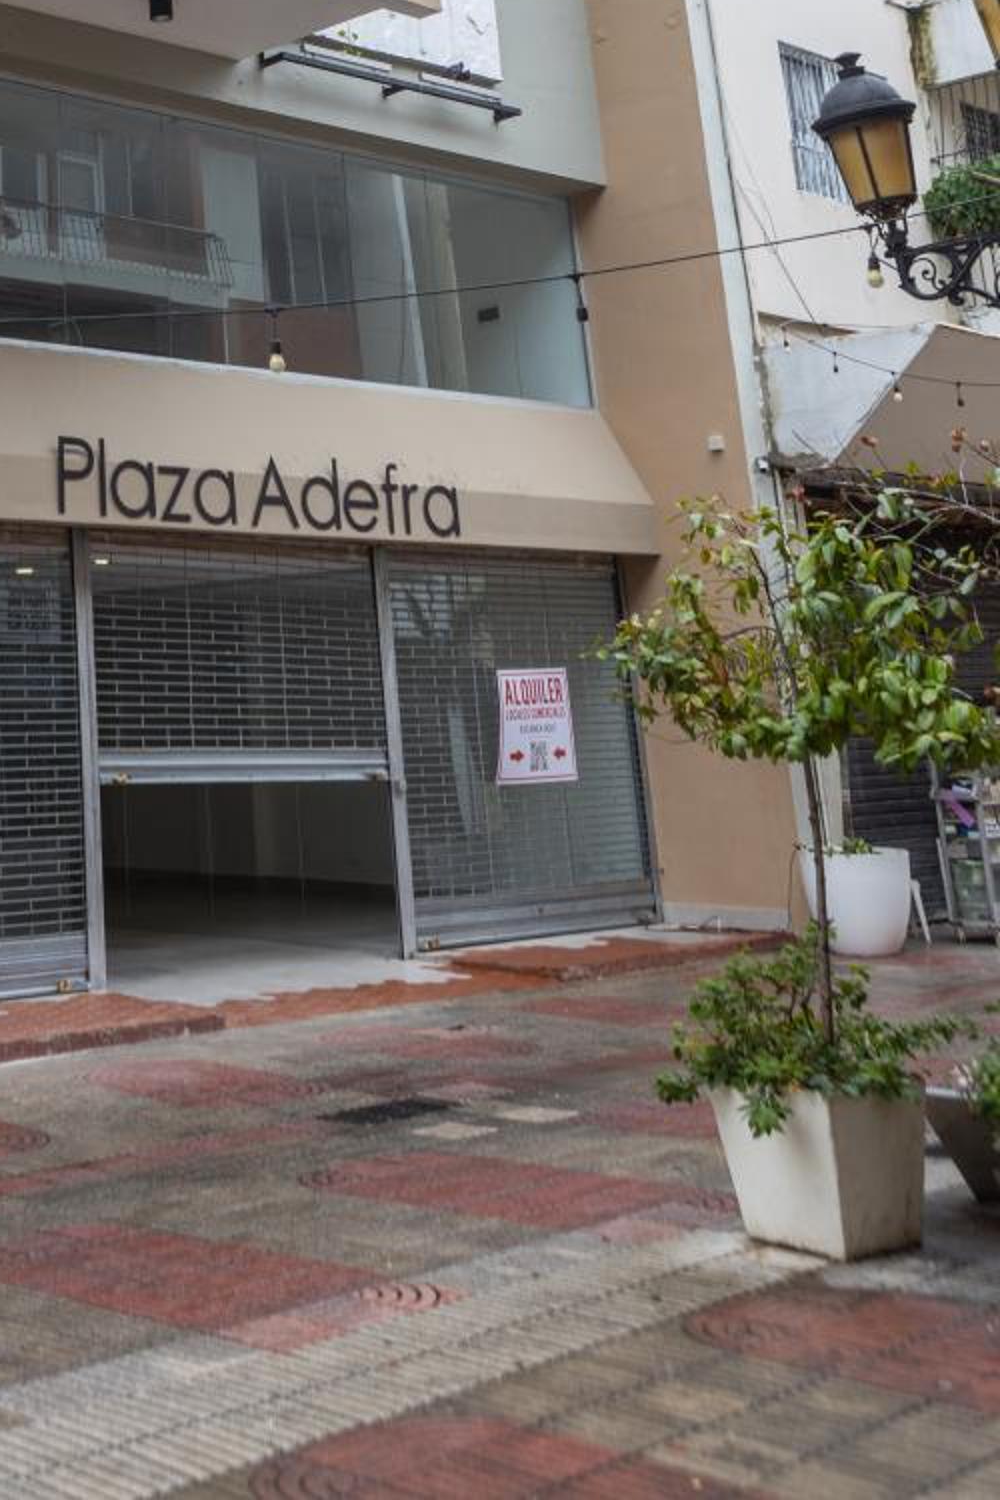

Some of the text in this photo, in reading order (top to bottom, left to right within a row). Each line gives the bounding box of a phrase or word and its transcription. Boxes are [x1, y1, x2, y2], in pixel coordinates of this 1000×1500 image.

[57, 435, 461, 538] Plaza Adefra
[504, 677, 563, 706] ALQUILER
